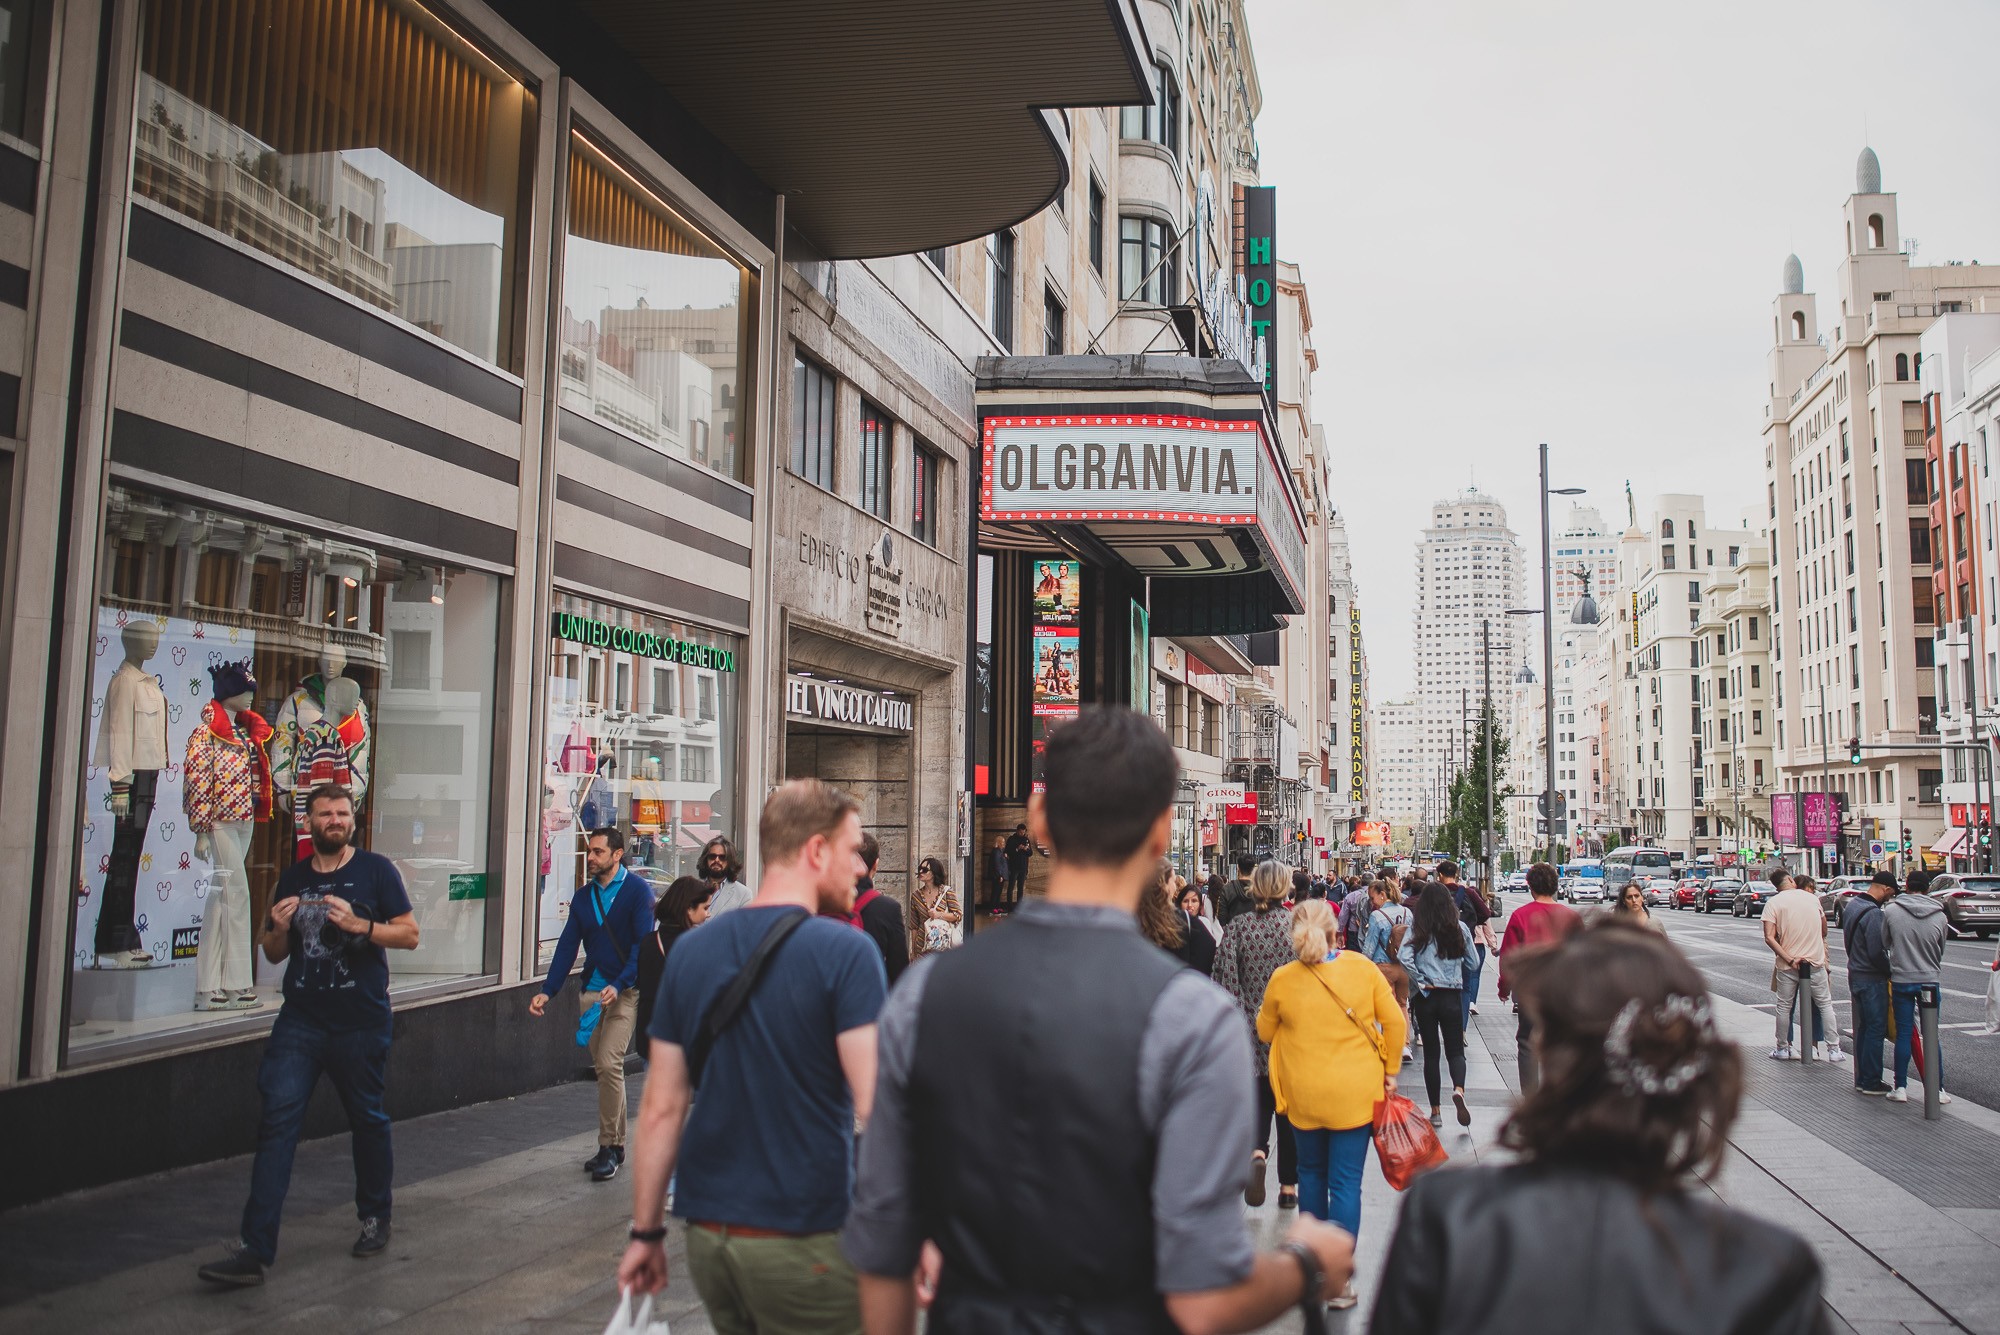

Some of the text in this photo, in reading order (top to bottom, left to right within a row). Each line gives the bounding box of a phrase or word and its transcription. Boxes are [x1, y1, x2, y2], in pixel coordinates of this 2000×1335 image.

[1250, 237, 1271, 390] HOT
[995, 443, 1252, 494] OLGRANVIA.
[799, 530, 860, 584] EDIFICIO
[559, 612, 736, 673] UNITED COLORS OF BENETTON.
[814, 684, 863, 723] VINCCI
[865, 694, 914, 731] CAPITOL
[1351, 609, 1363, 801] HOTEL EMPERADOR
[1206, 789, 1242, 797] GINOS
[175, 930, 199, 947] MIC
